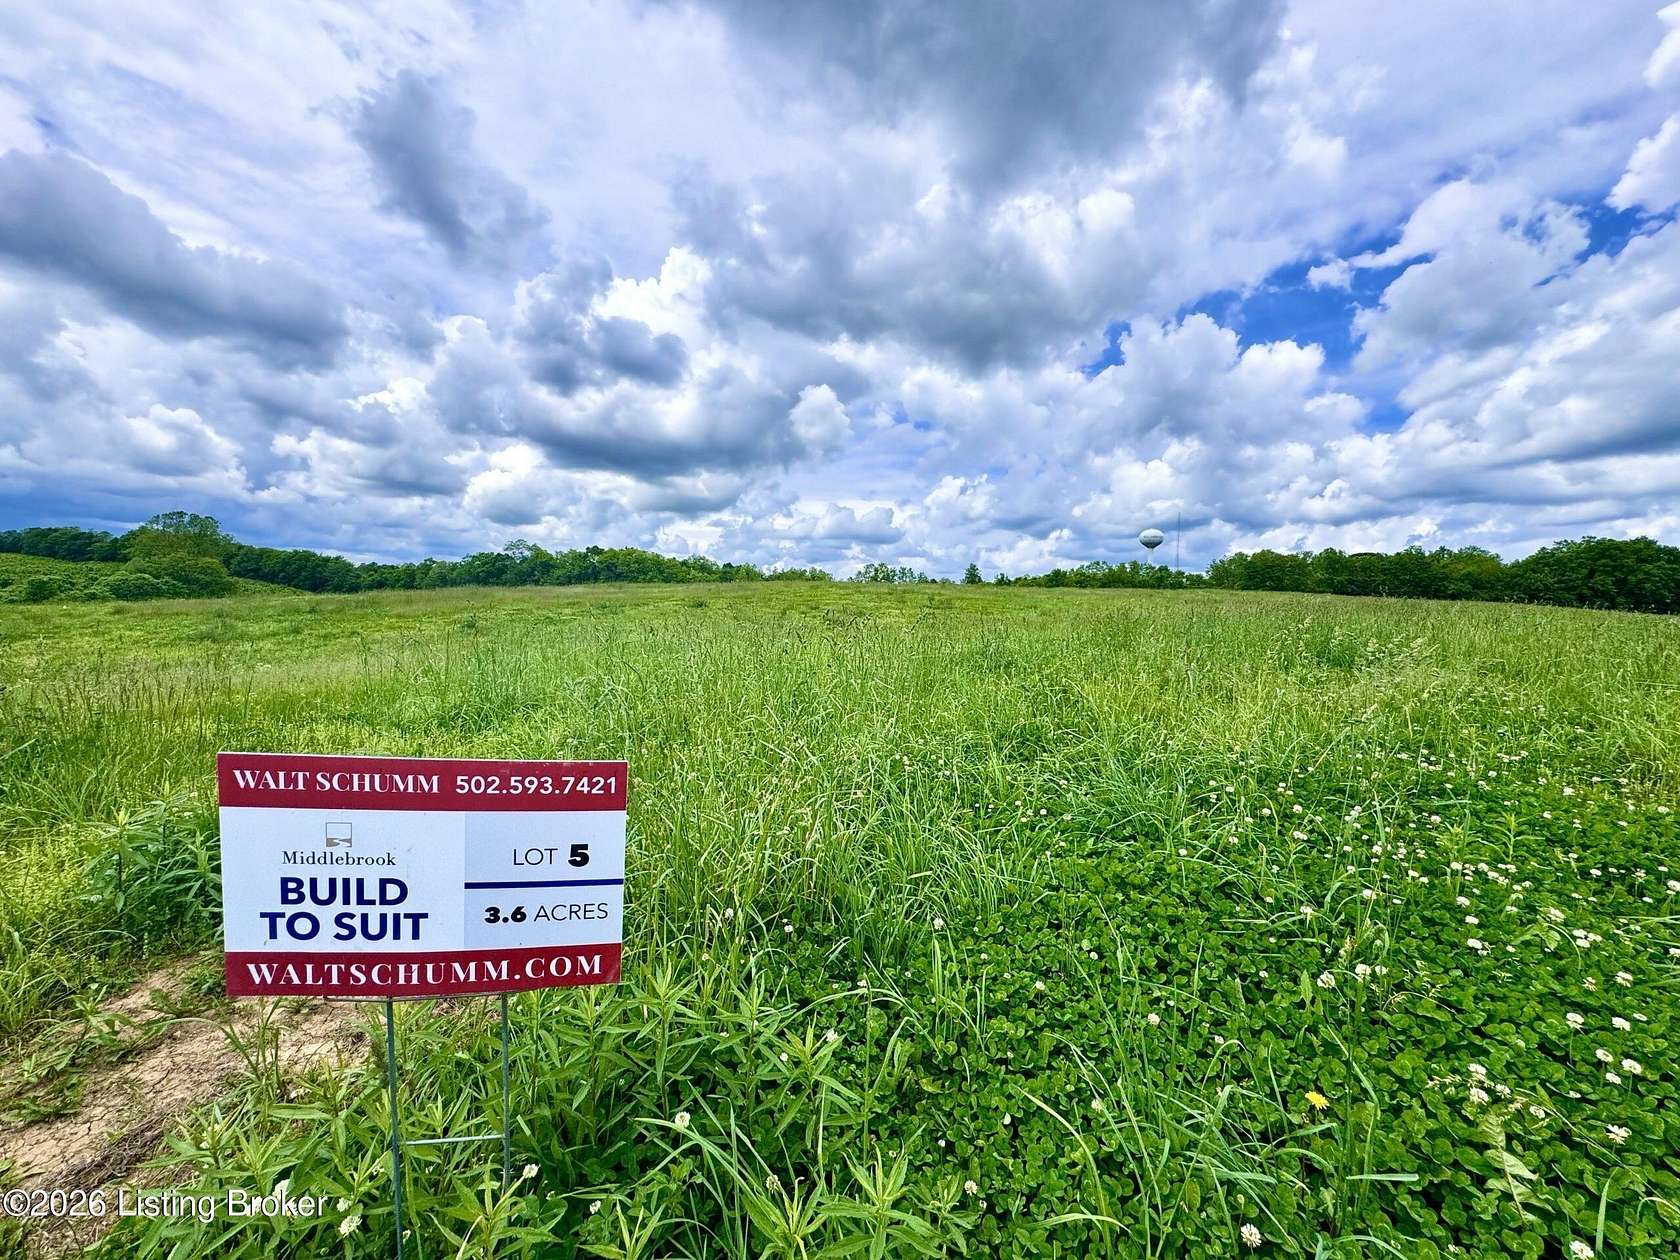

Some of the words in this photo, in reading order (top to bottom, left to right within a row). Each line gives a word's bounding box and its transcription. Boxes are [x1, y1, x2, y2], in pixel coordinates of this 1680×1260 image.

[232, 769, 310, 792] WALT
[316, 770, 440, 794] SCHUMM
[455, 775, 618, 795] 502.593.7421
[282, 850, 396, 866] Middlebrook
[513, 848, 558, 867] LOT
[567, 843, 590, 868] 5
[280, 876, 408, 906] BUILD
[484, 905, 527, 924] 3.6
[533, 902, 609, 922] ACRES
[259, 911, 320, 941] TO
[333, 911, 429, 941] SUIT
[246, 953, 603, 986] WALTSCHUMM.COM
